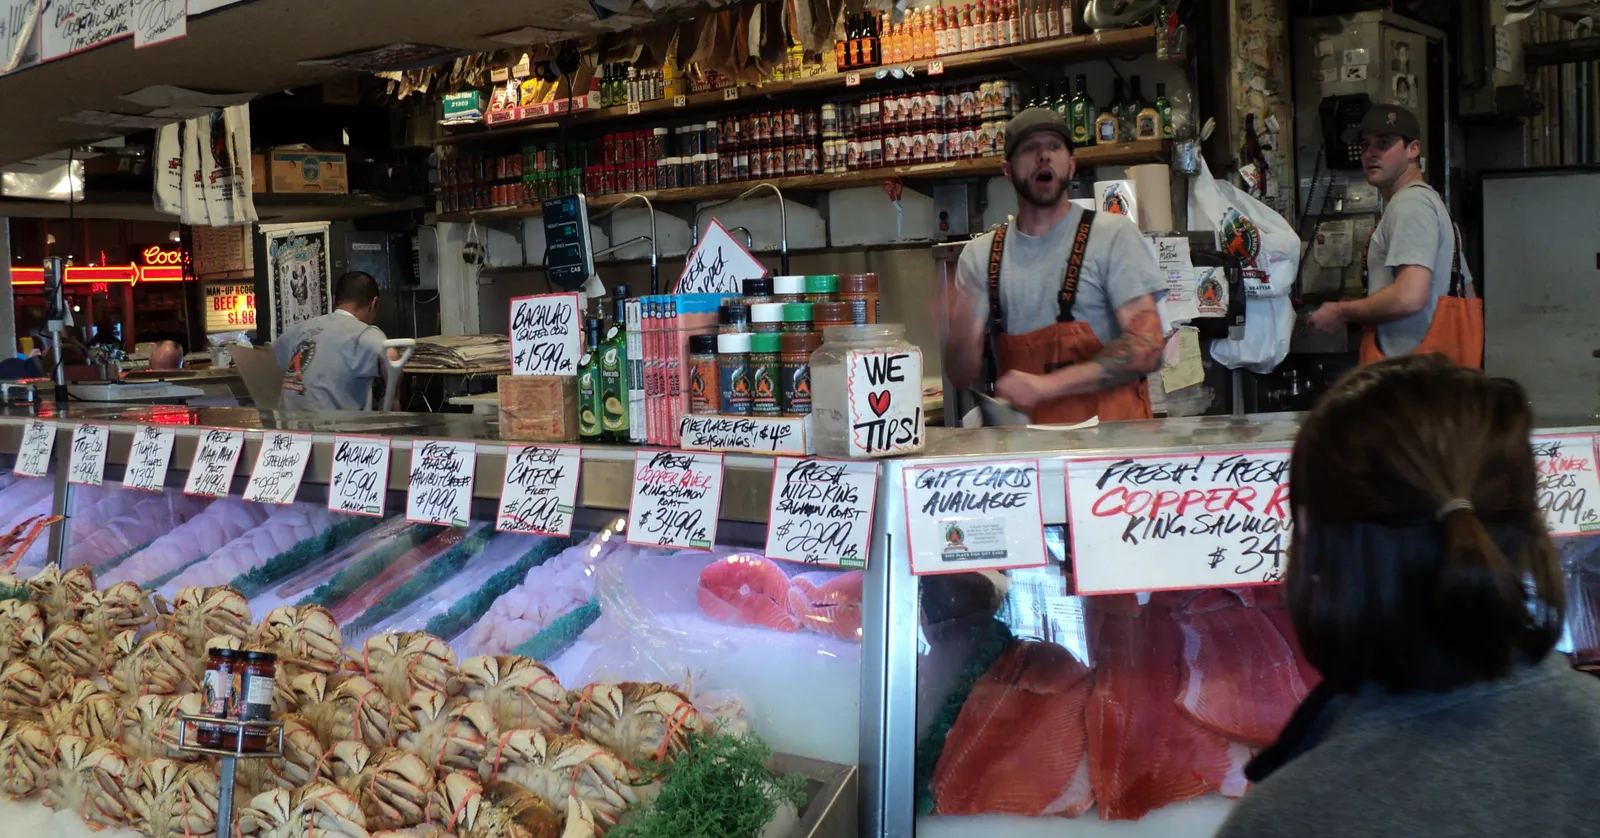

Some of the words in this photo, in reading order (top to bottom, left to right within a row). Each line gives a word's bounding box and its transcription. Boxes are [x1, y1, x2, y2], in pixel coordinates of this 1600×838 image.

[726, 89, 736, 98] $4
[629, 104, 639, 113] $4
[206, 286, 234, 296] MAN-UP
[213, 295, 238, 311] BEEF
[512, 302, 572, 331] BACALAO
[863, 352, 910, 386] WE
[680, 417, 702, 437] PIKE
[702, 418, 733, 434] PLACE
[732, 418, 759, 435] FISH
[853, 406, 920, 453] TIPS!
[334, 440, 383, 467] BACALAO
[420, 440, 459, 460] FRESH
[516, 446, 565, 466] FRESH
[649, 450, 700, 471] FRESH
[506, 461, 566, 488] CATFISH
[636, 464, 679, 485] COPPER
[678, 468, 713, 489] RIVER
[786, 459, 852, 485] FRESH
[914, 468, 977, 490] GIFT
[972, 465, 1036, 490] CARDS
[1096, 456, 1205, 490] FRESH!
[639, 482, 666, 497] KING
[664, 484, 708, 500] SALMON
[780, 483, 822, 500] WILD
[821, 482, 859, 504] KING
[340, 500, 364, 512] CANADA
[656, 497, 690, 509] ROAST
[775, 498, 827, 517] SALMON
[826, 504, 868, 521] ROAST
[921, 489, 1032, 517] AVAILABLE
[1091, 485, 1258, 521] COPPER
[1122, 512, 1186, 546] KING
[1189, 513, 1294, 538] SALMON
[658, 536, 674, 545] USA
[803, 554, 828, 564] USA
